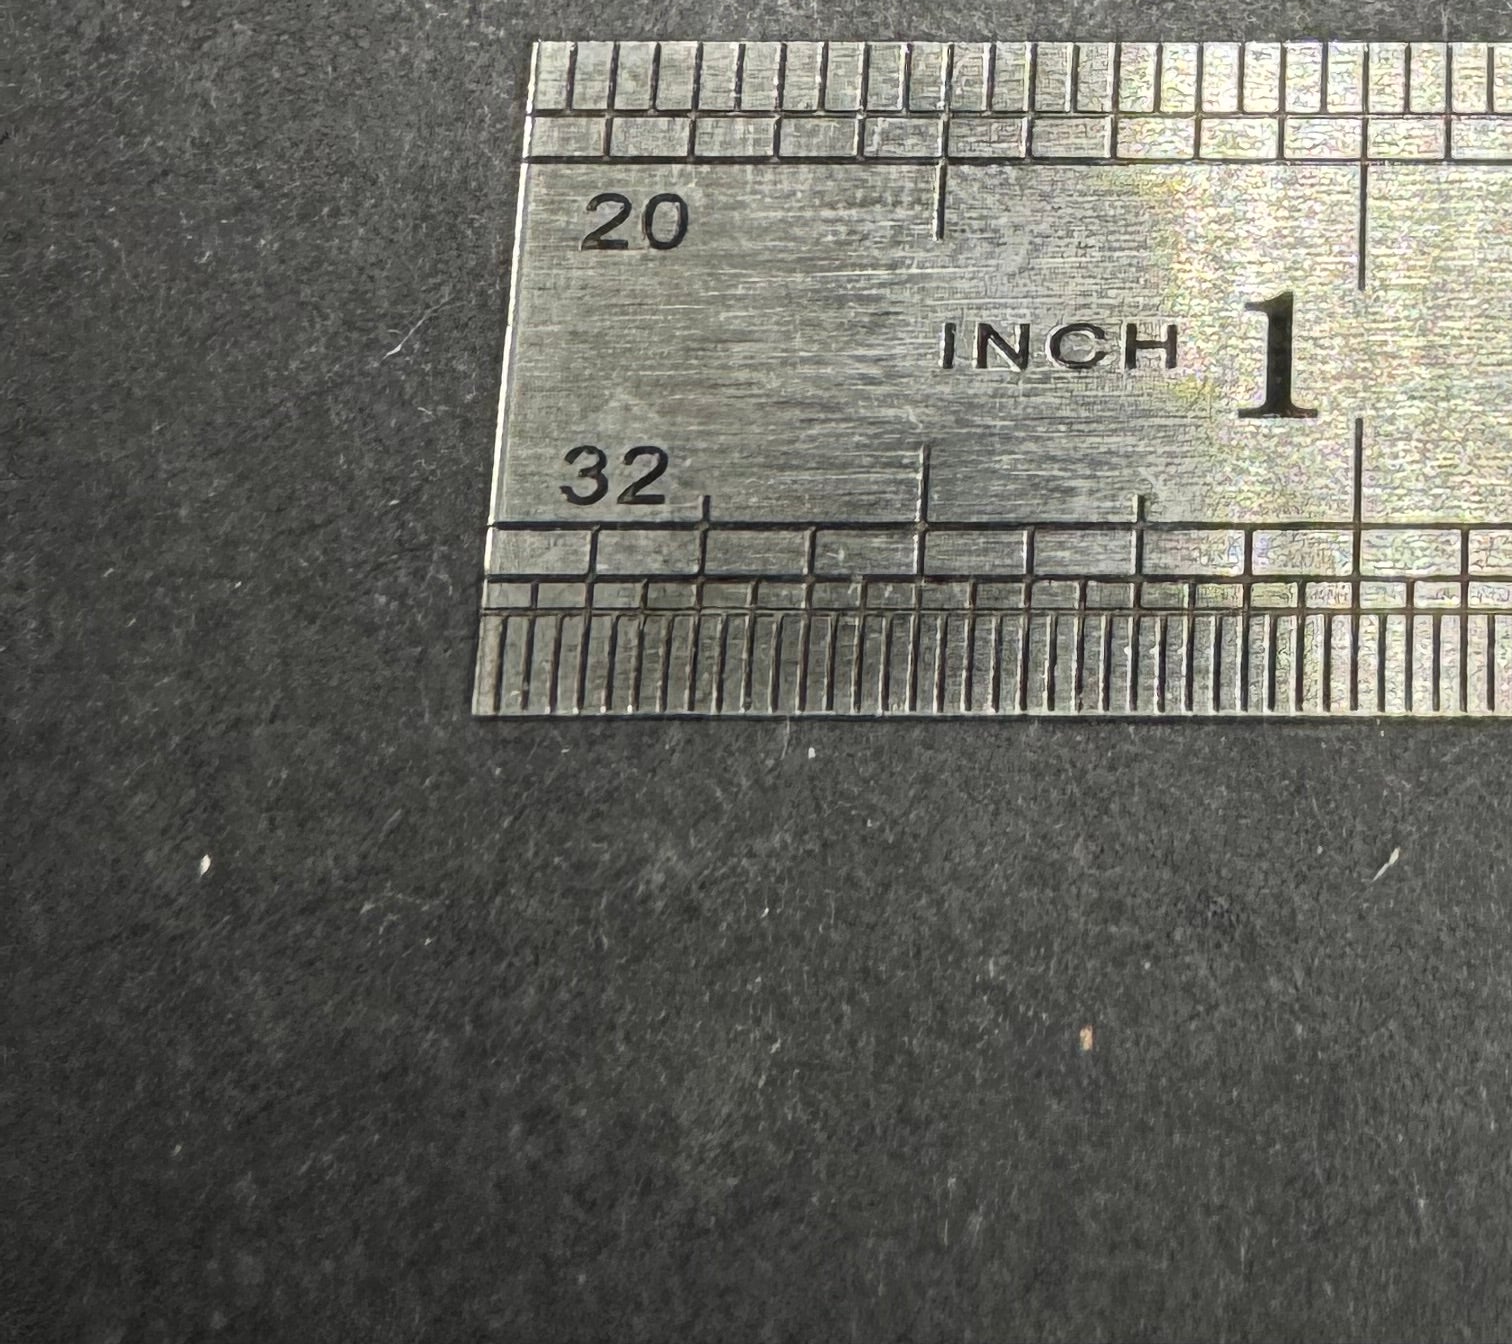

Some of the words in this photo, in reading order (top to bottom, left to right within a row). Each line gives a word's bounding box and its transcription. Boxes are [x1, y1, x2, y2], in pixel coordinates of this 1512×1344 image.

[581, 193, 689, 250] 20
[940, 321, 1178, 370] INCH
[1237, 291, 1318, 419] 1
[559, 445, 668, 506] 32
